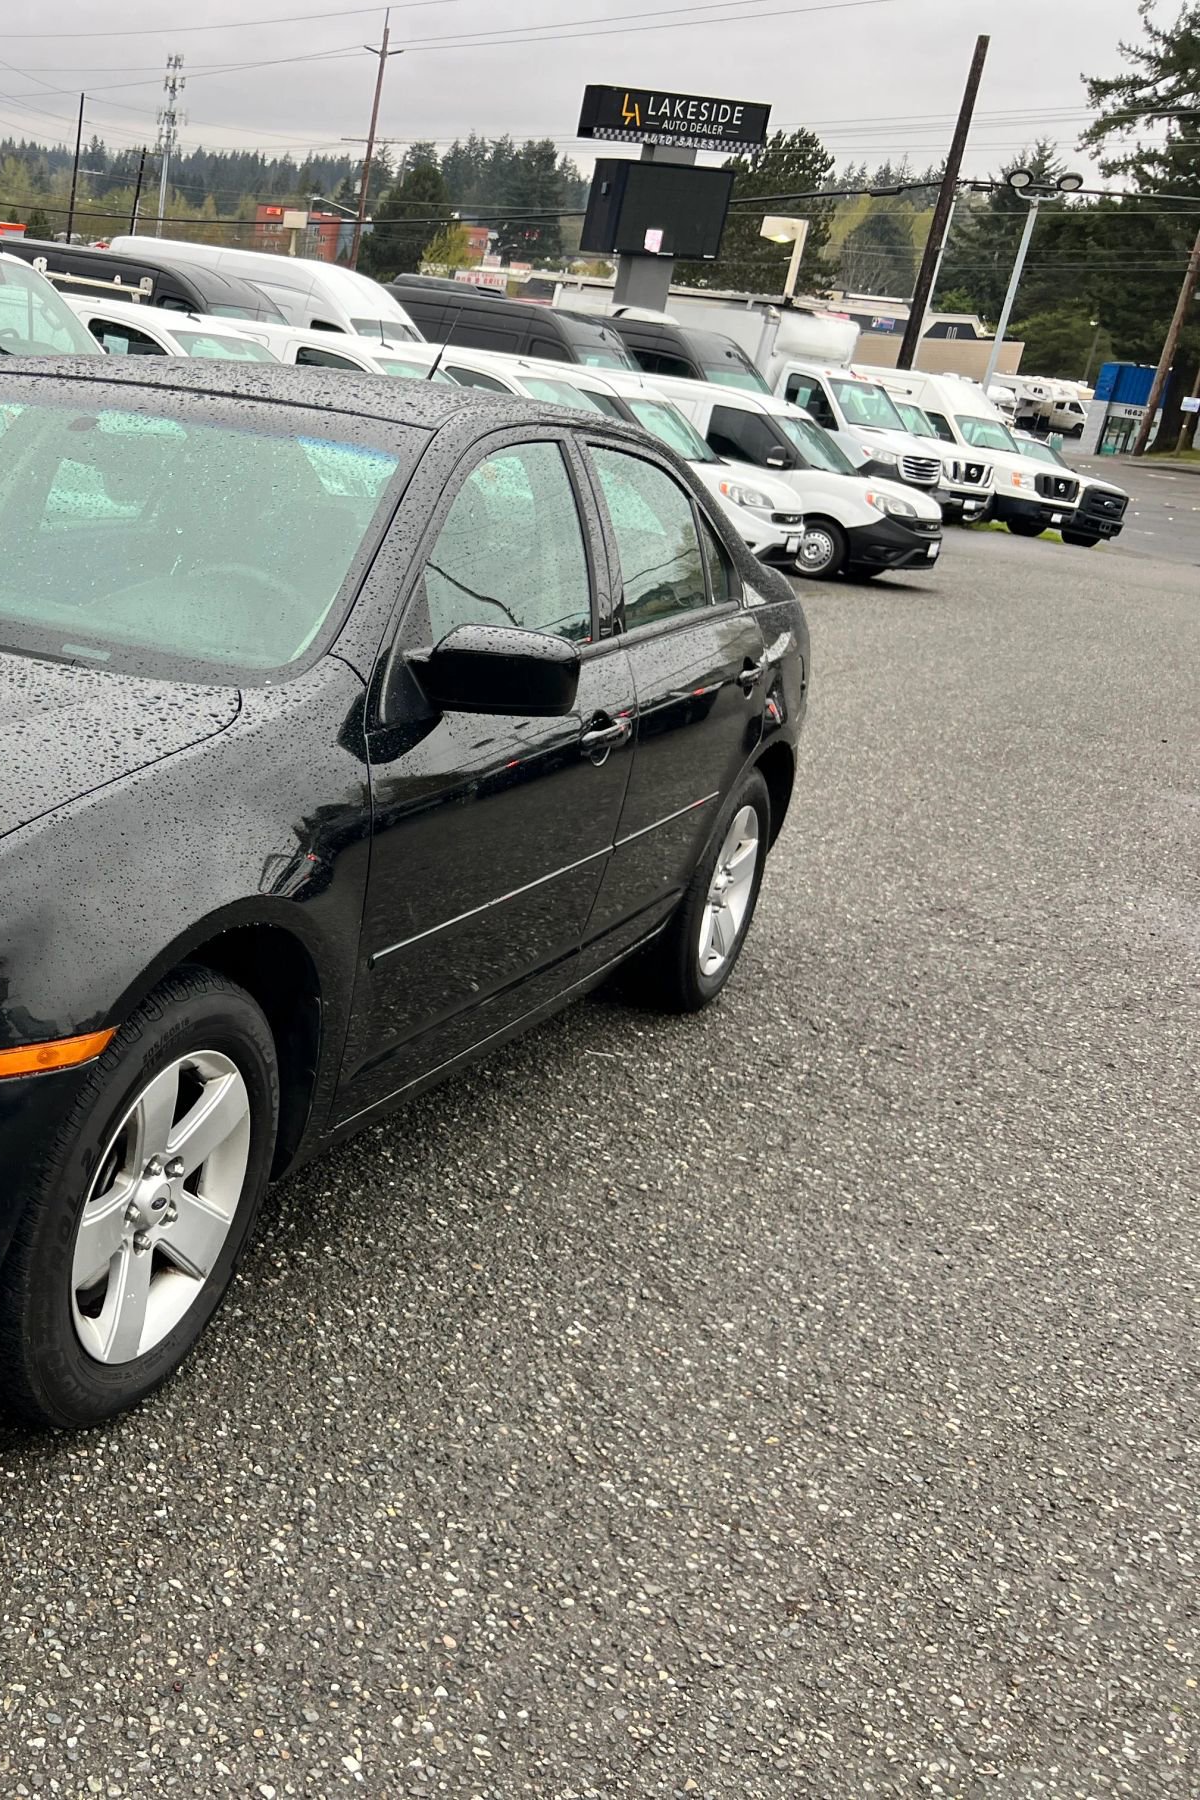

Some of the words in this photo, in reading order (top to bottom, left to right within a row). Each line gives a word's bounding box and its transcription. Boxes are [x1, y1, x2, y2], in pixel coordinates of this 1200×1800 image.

[647, 96, 744, 125] LAKESIDE
[662, 120, 688, 132] AUTO
[690, 123, 723, 135] DEALER
[677, 137, 715, 149] SALES
